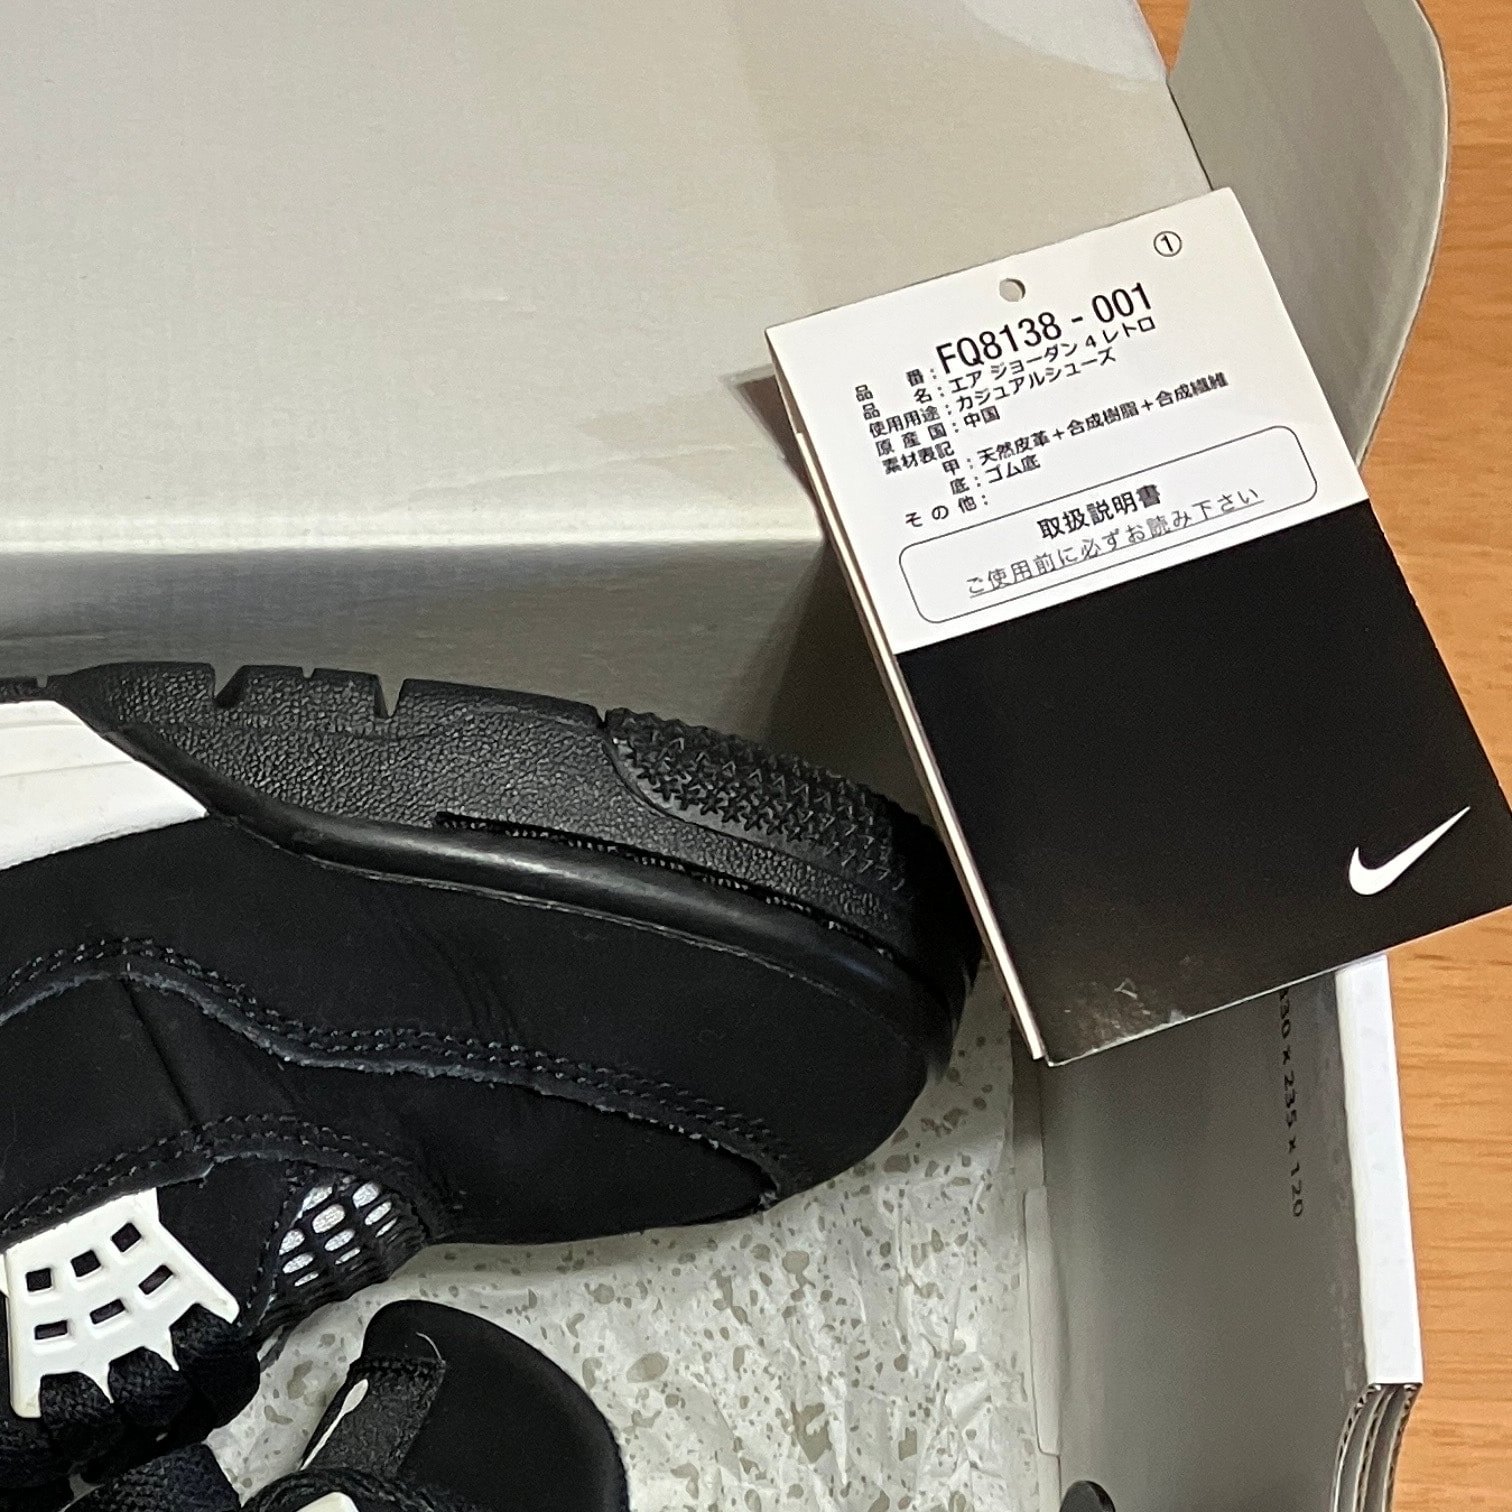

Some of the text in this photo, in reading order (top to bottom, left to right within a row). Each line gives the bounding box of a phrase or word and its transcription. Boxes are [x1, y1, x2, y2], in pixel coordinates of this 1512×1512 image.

[1036, 484, 1162, 540] 取扱説明書
